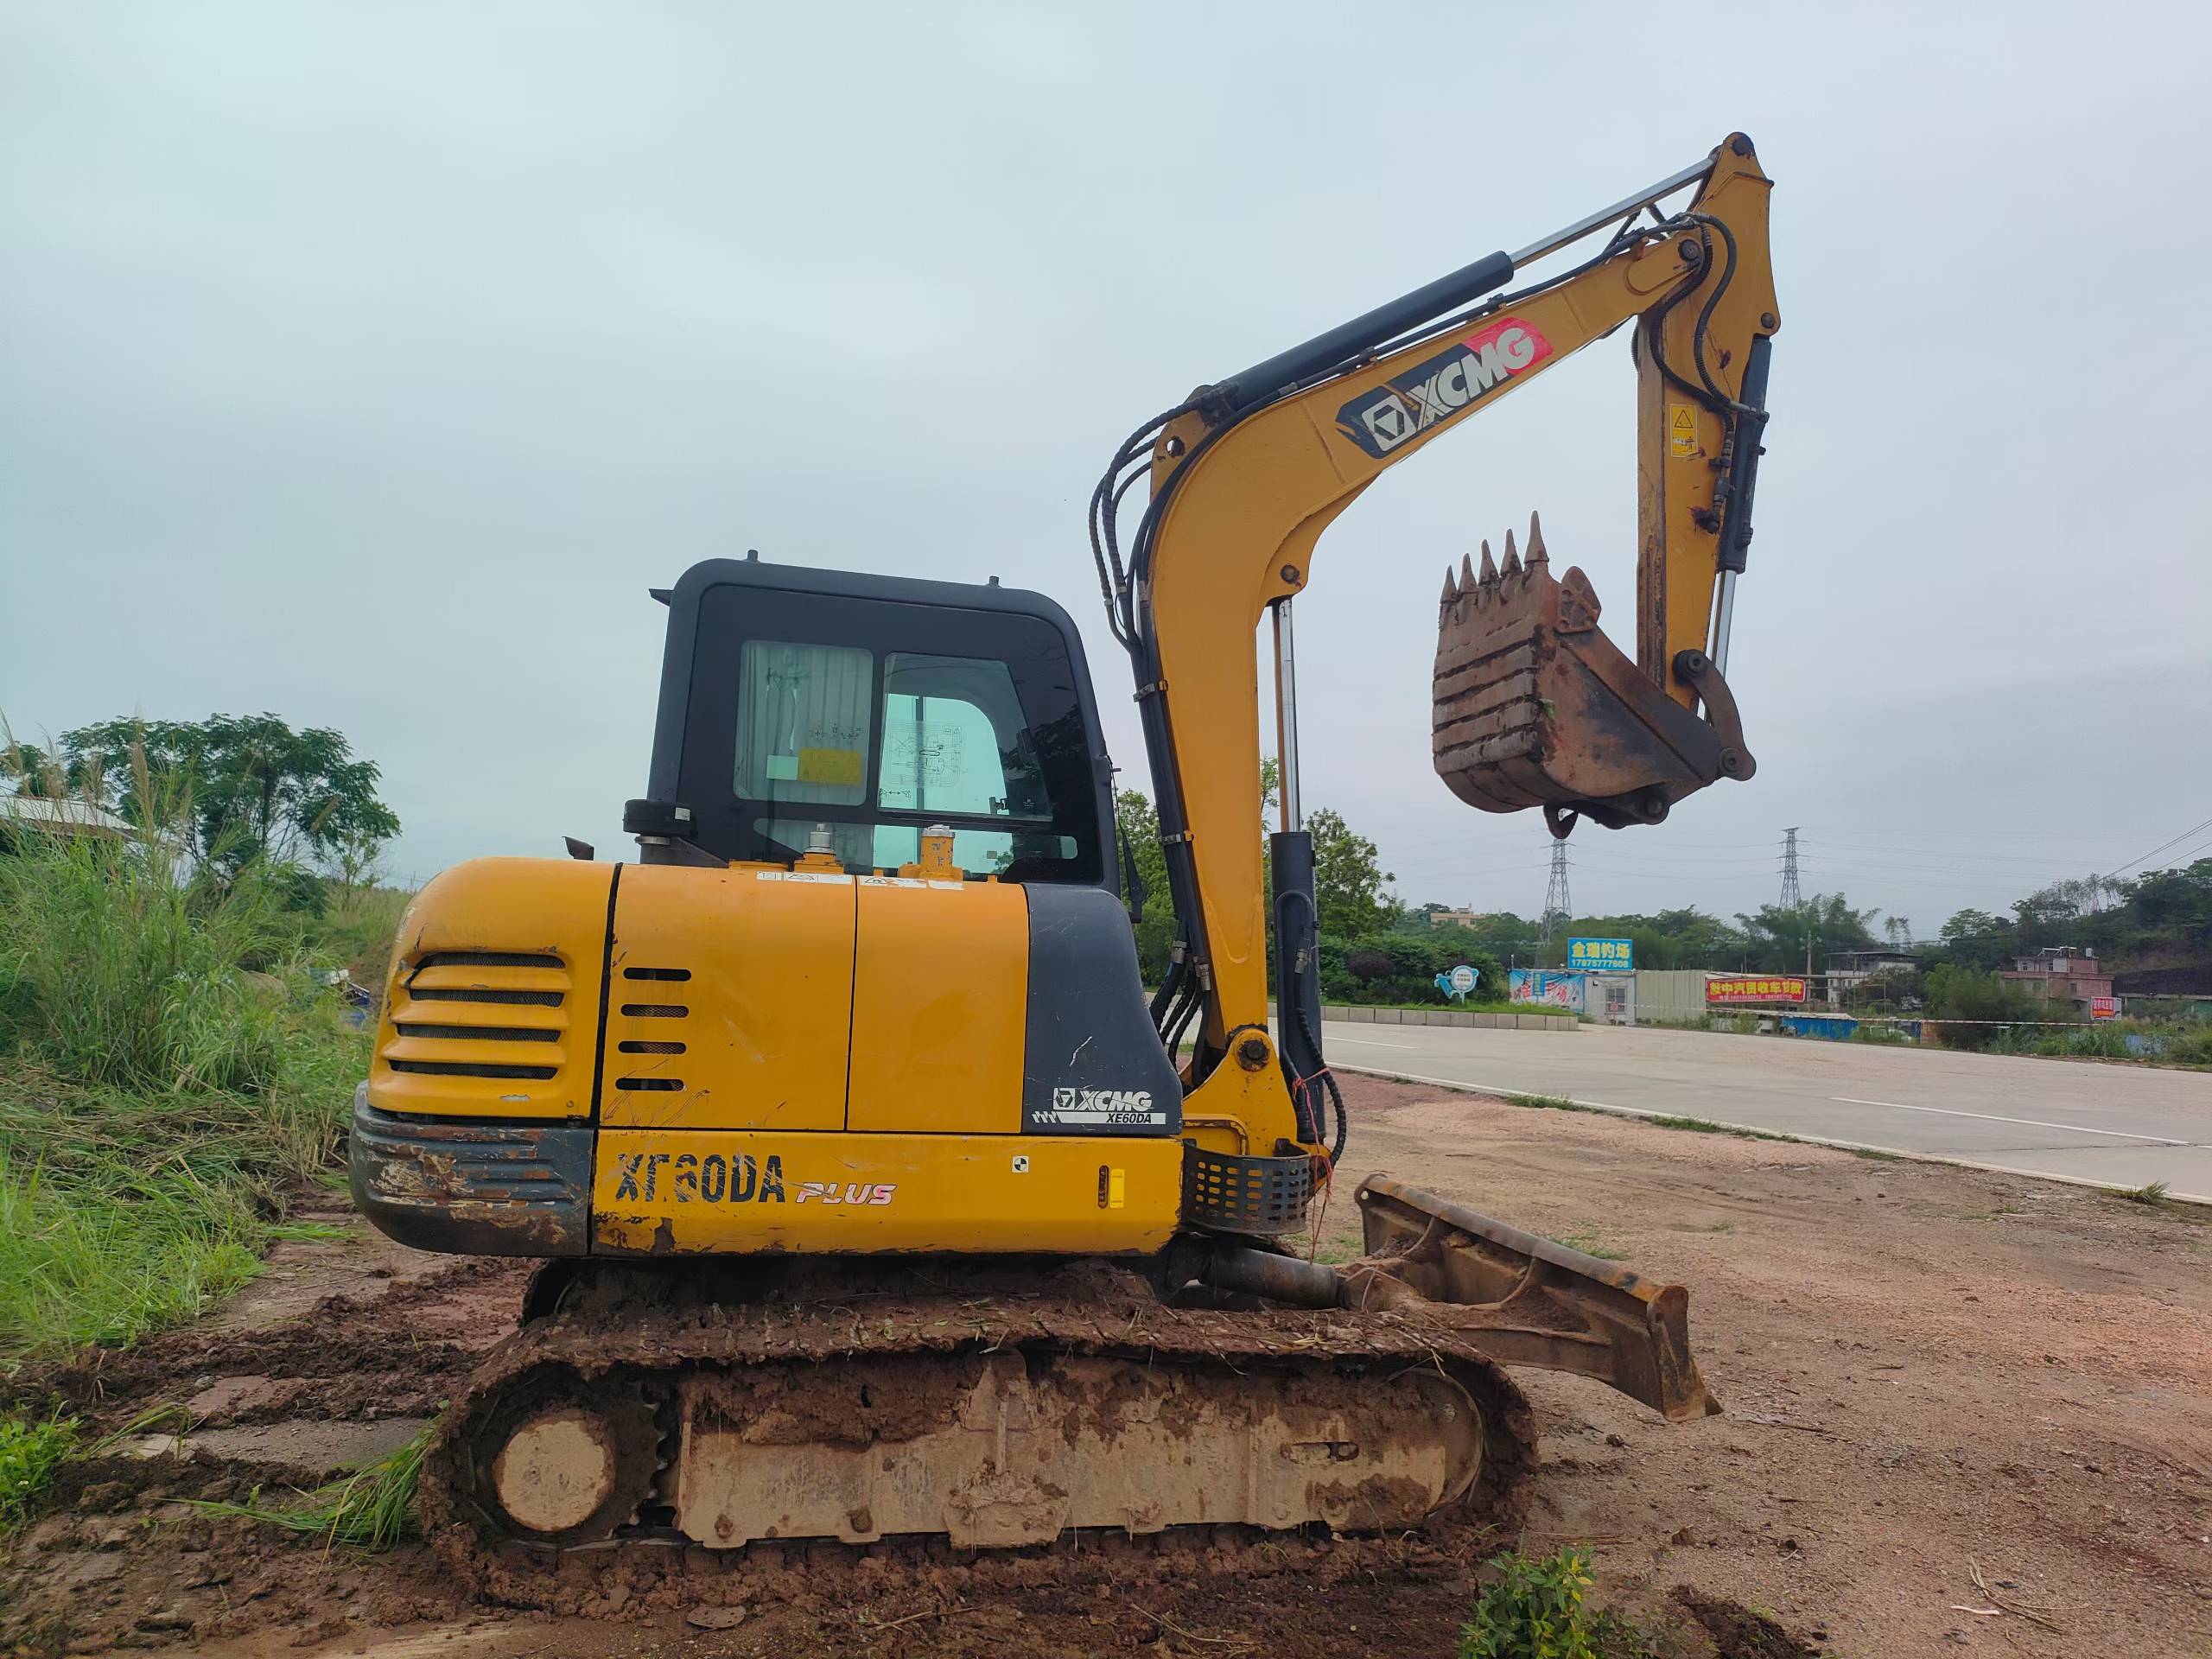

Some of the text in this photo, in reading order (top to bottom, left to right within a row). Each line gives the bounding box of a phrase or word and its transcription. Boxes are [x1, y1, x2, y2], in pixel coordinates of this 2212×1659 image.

[1406, 327, 1535, 432] XCMG
[1074, 1090, 1153, 1112] XCMG
[1106, 1113, 1152, 1123] XE60DA
[795, 1182, 898, 1205] PLUS
